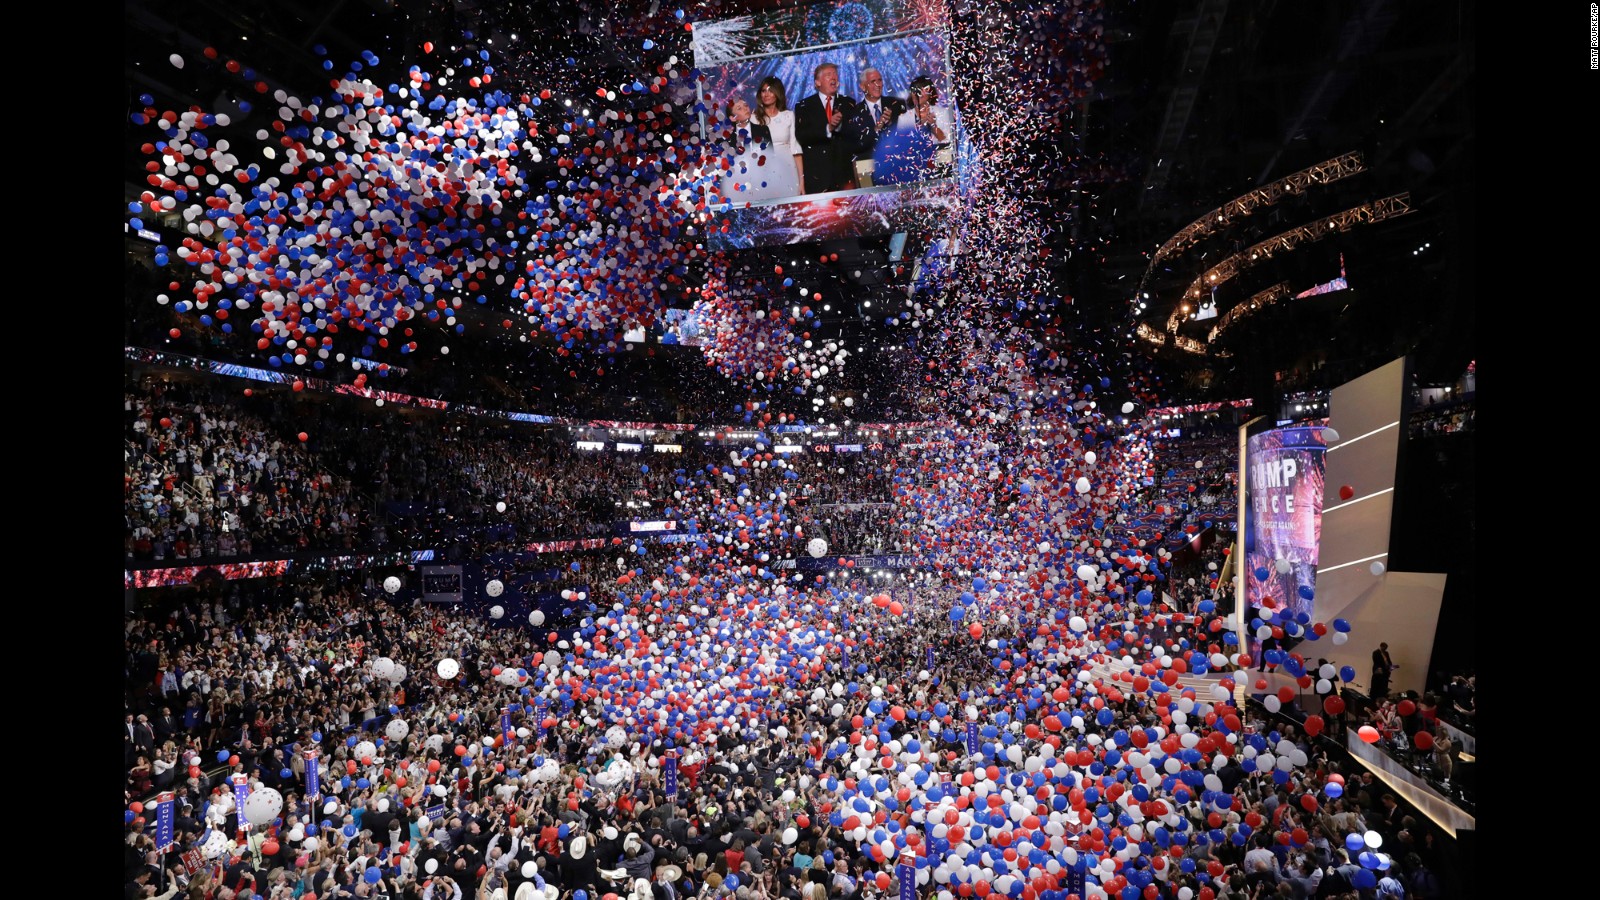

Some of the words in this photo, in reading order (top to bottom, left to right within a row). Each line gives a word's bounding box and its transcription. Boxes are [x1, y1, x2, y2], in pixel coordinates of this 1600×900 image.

[814, 444, 830, 453] CNN
[1251, 459, 1297, 489] RUMP
[1254, 495, 1295, 513] ENCE
